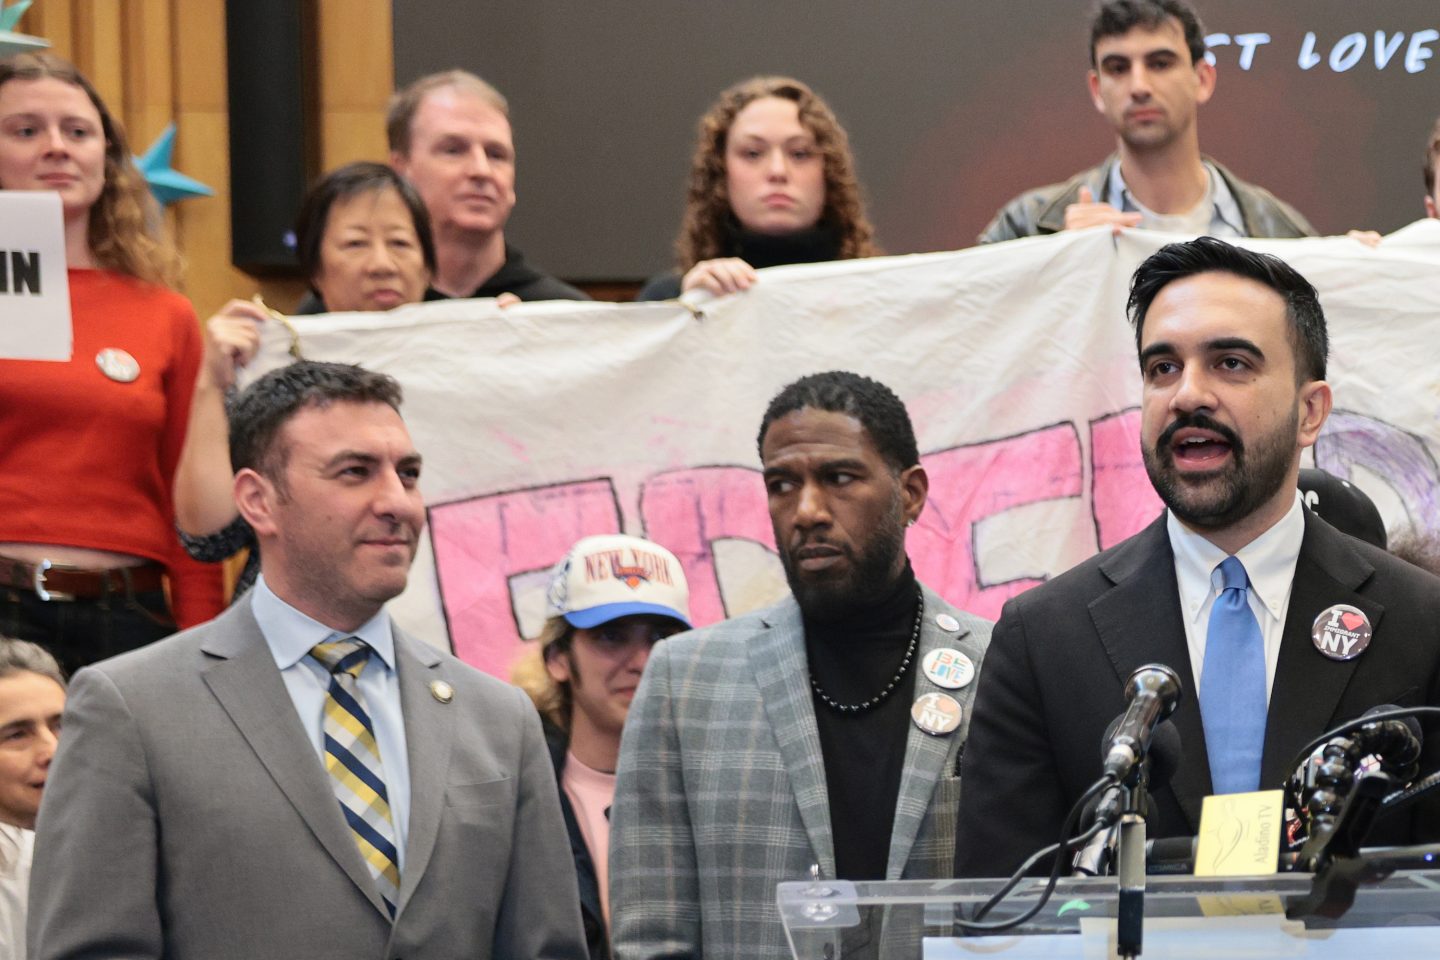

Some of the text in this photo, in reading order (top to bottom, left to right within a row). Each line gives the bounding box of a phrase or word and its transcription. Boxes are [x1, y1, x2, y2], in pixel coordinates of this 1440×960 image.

[1298, 29, 1440, 74] LOVE
[1328, 608, 1343, 628] I
[1321, 631, 1358, 655] NY
[1257, 804, 1273, 820] TV
